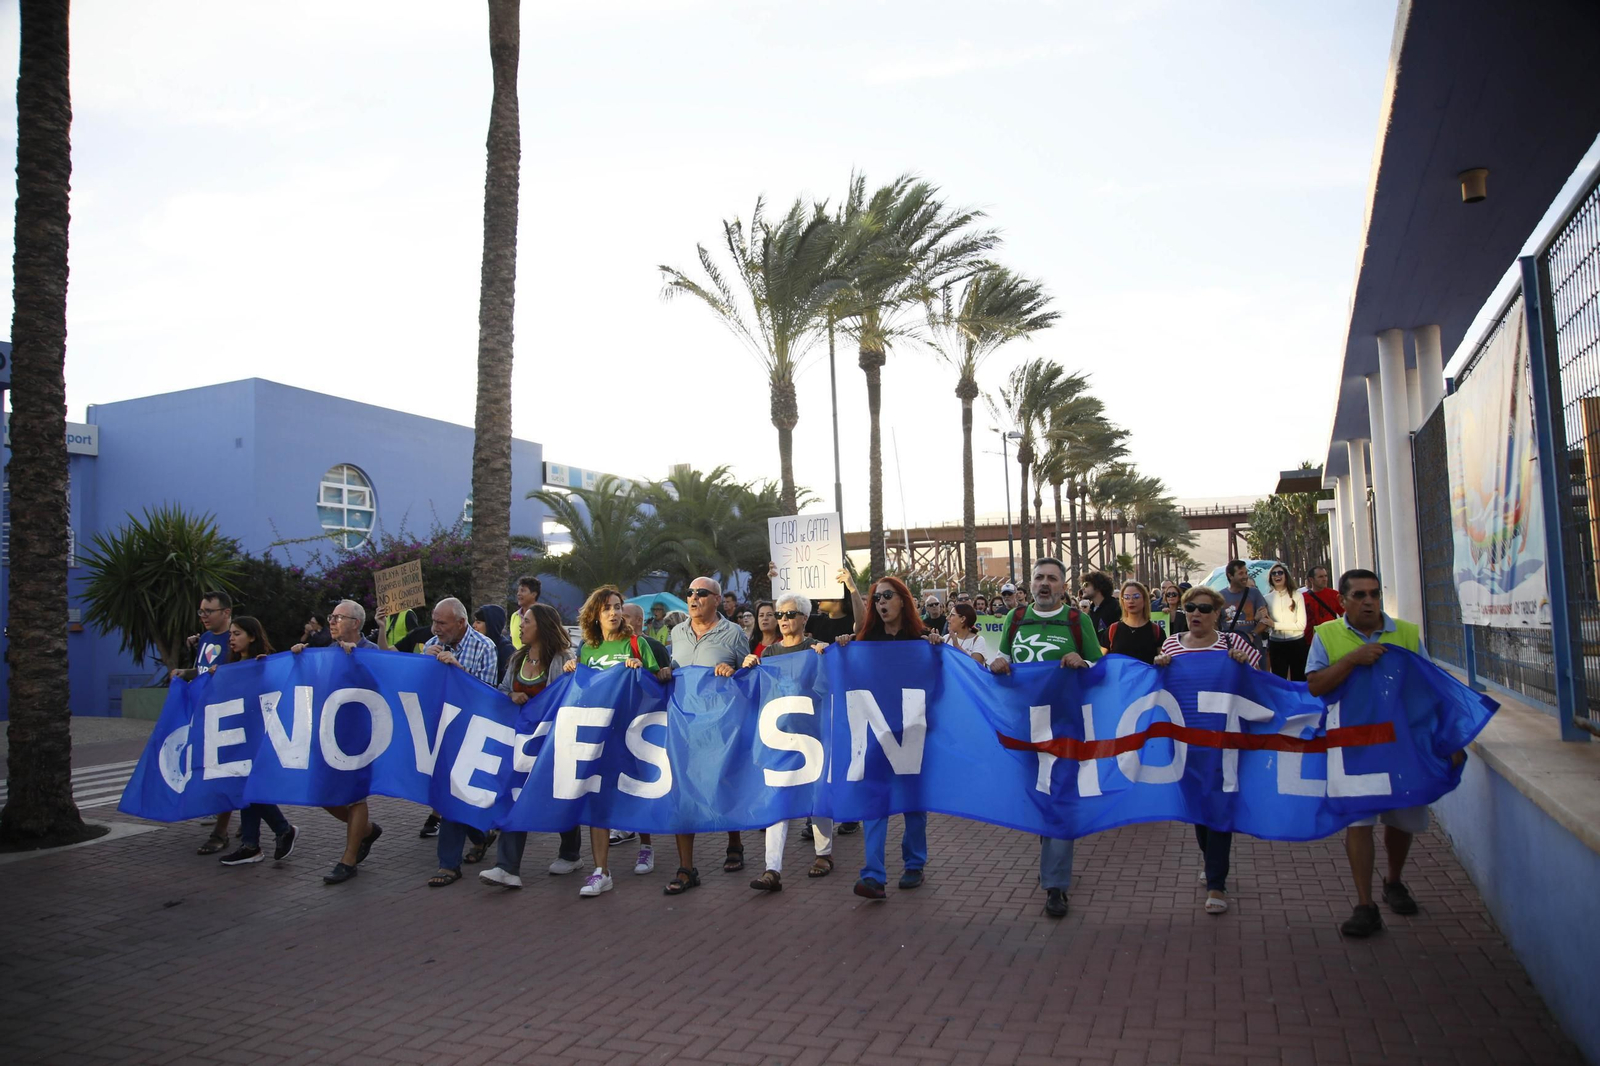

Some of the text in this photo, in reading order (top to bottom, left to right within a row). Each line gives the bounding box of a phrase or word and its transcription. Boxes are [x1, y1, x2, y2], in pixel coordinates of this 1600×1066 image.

[774, 519, 798, 545] CABO
[806, 517, 830, 542] GATA
[795, 544, 811, 563] NO
[382, 569, 399, 581] PLAYA
[401, 565, 407, 575] DE
[409, 561, 419, 573] LOS
[779, 567, 791, 591] SE
[379, 594, 390, 605] NO
[758, 688, 927, 787] SN
